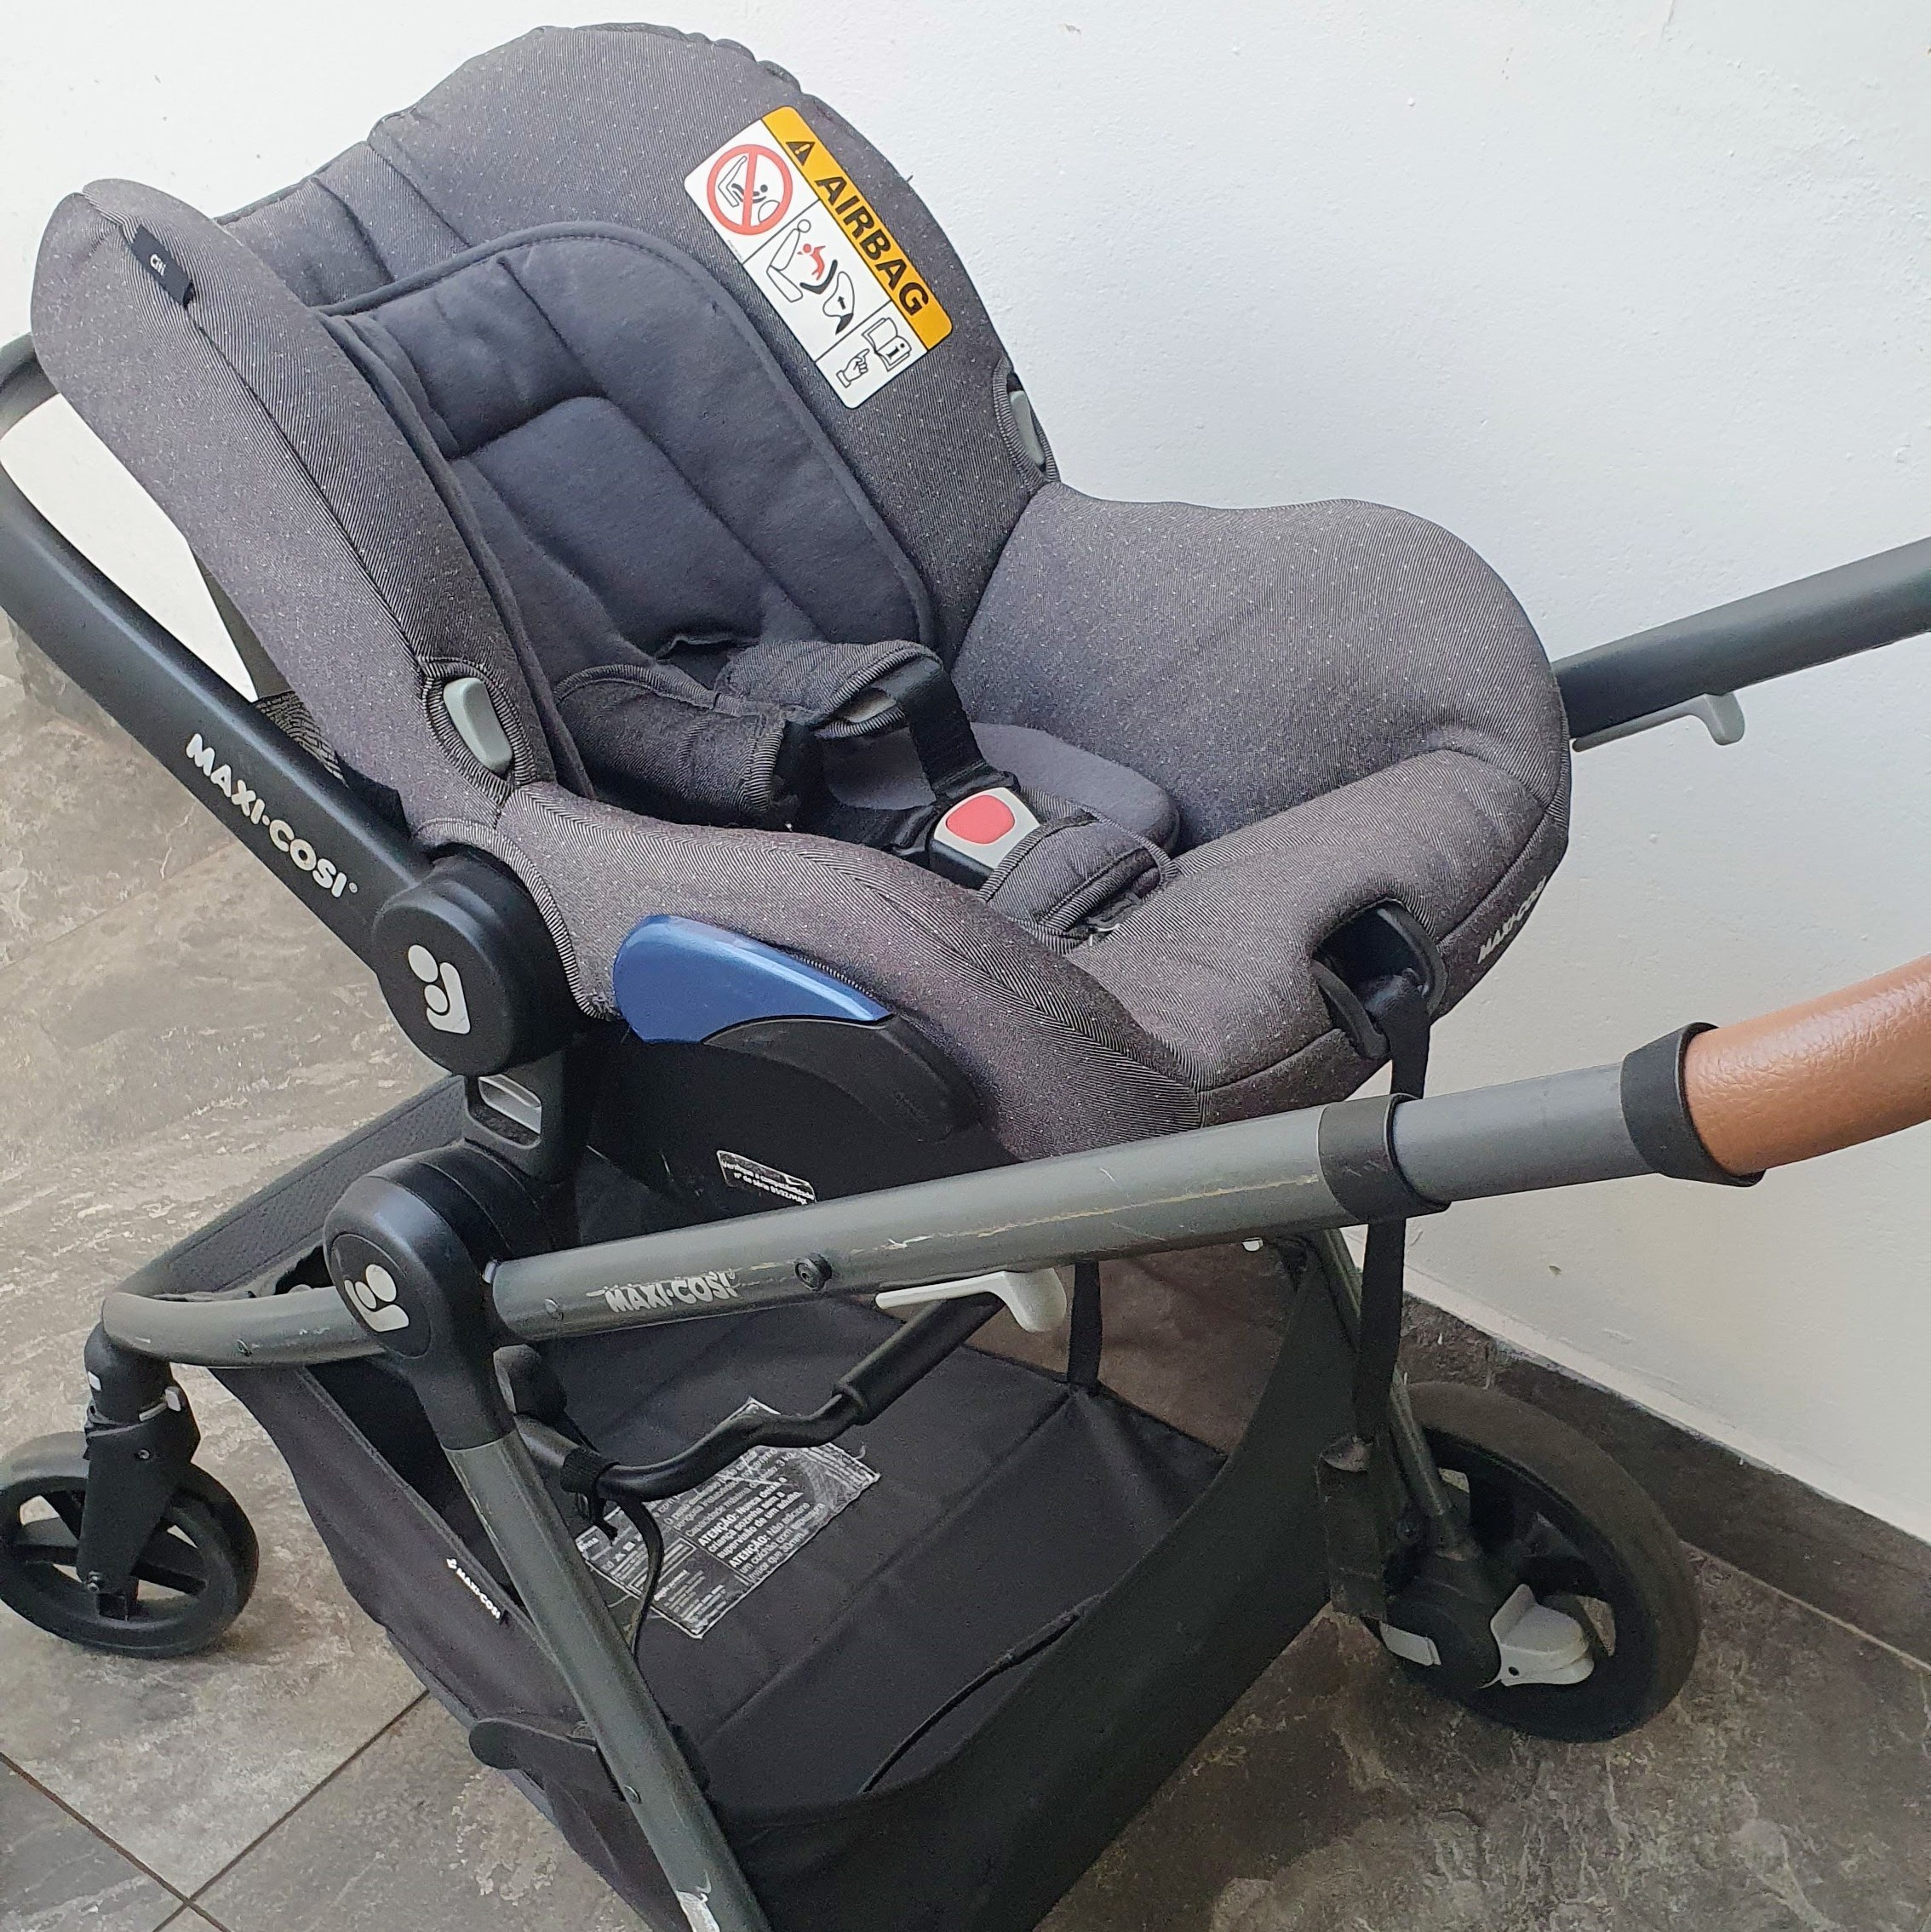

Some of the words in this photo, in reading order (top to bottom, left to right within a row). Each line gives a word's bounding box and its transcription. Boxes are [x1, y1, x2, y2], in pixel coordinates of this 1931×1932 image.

[814, 176, 929, 316] AIRBAG
[696, 1511, 739, 1546] ATENÇÃO:
[735, 1495, 761, 1515] Nunca
[707, 1528, 737, 1552] criança
[732, 1505, 764, 1531] sozinha
[713, 1524, 758, 1559] supervisão
[727, 1533, 771, 1568] ATENÇÃO:
